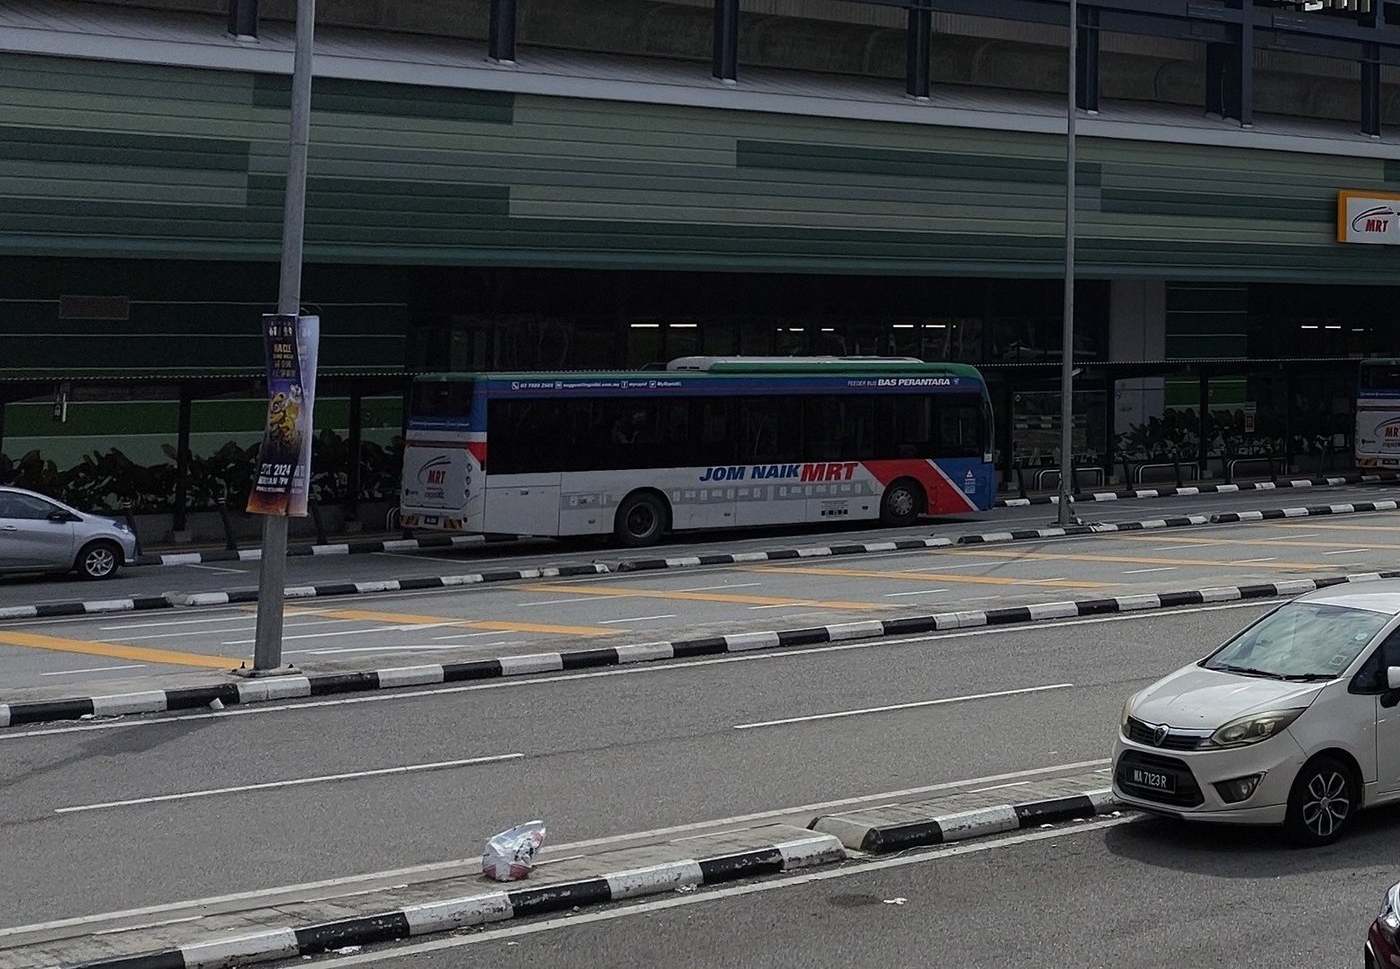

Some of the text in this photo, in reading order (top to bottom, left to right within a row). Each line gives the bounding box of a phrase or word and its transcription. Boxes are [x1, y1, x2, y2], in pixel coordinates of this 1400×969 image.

[1365, 219, 1388, 233] MRT
[877, 378, 897, 386] BAS
[897, 378, 951, 386] PERANTARA
[427, 470, 446, 484] MRT
[699, 462, 858, 482] JOM NAIK MRT
[1143, 771, 1160, 787] 7123
[1160, 775, 1167, 789] R
